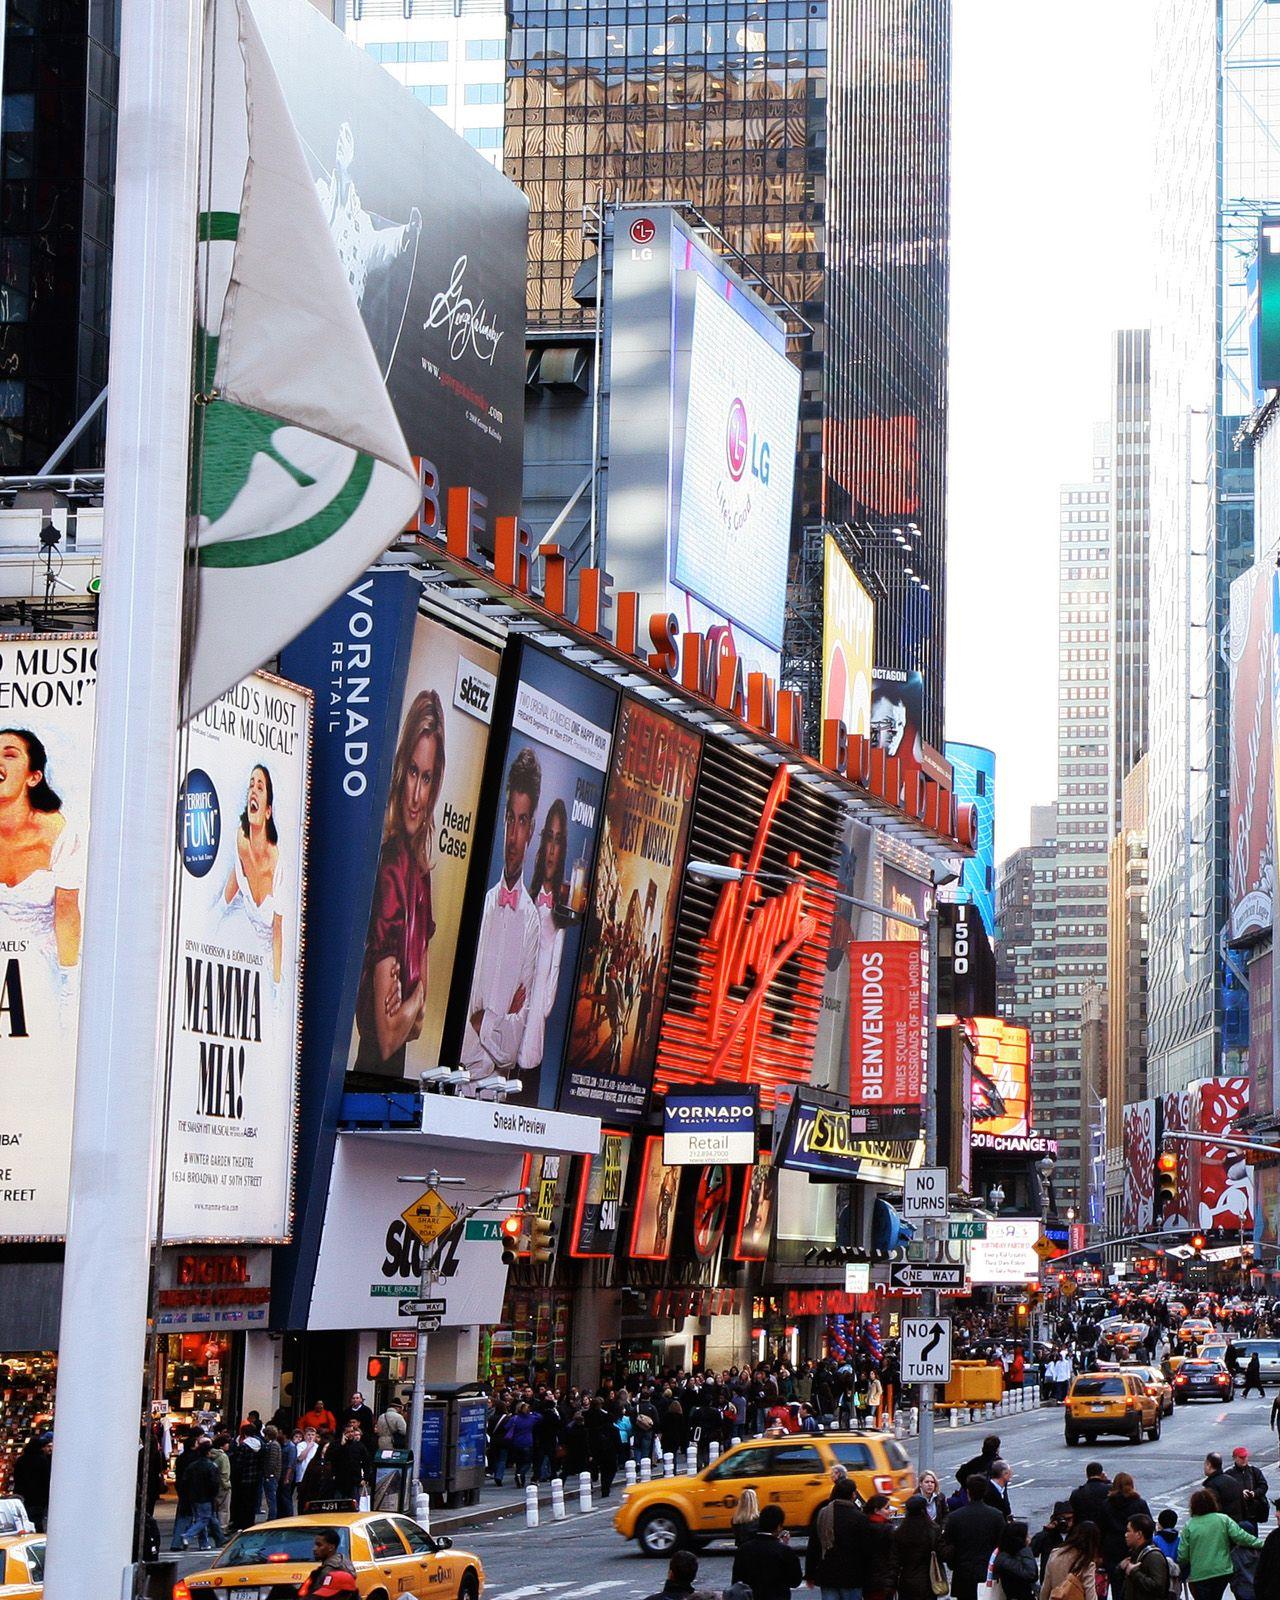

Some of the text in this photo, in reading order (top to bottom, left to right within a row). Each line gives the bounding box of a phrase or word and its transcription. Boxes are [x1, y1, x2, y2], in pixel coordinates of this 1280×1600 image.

[632, 249, 652, 260] LG
[750, 442, 770, 486] LG
[328, 641, 344, 733] RETAIL
[342, 579, 374, 798] VORNADO
[263, 696, 297, 728] MOST
[570, 720, 581, 737] ONE
[580, 725, 595, 745] HAPPY
[442, 802, 472, 834] Head
[571, 800, 596, 829] DOWN
[438, 828, 468, 860] Case
[954, 905, 969, 975] 1500
[182, 956, 262, 1043] MAMMA
[861, 951, 884, 1100] BIENVENIDOS
[908, 951, 919, 1098] CROSSROADS OF THE WORLD
[896, 1021, 907, 1098] TIMES SQUARE
[196, 1041, 246, 1120] MIA!
[665, 1105, 754, 1119] VORNADO
[851, 1107, 906, 1116] TIMES NYC
[493, 1111, 547, 1136] Sneak Preview
[688, 1136, 729, 1149] Retail
[995, 1136, 1046, 1152] CHANGE
[189, 1152, 254, 1169] WINTER GARDEN THEATRE
[171, 1171, 186, 1183] 1634
[187, 1171, 219, 1185] BROADWAY
[243, 1175, 263, 1187] STREET
[917, 1176, 935, 1191] NO
[906, 1196, 945, 1210] TURNS
[483, 1224, 489, 1236] 7
[951, 1223, 986, 1238] W 46 ST
[901, 1271, 956, 1281] ONE WAY
[371, 1285, 391, 1293] LITTLE
[907, 1324, 929, 1337] NO
[908, 1364, 944, 1376] TURN
